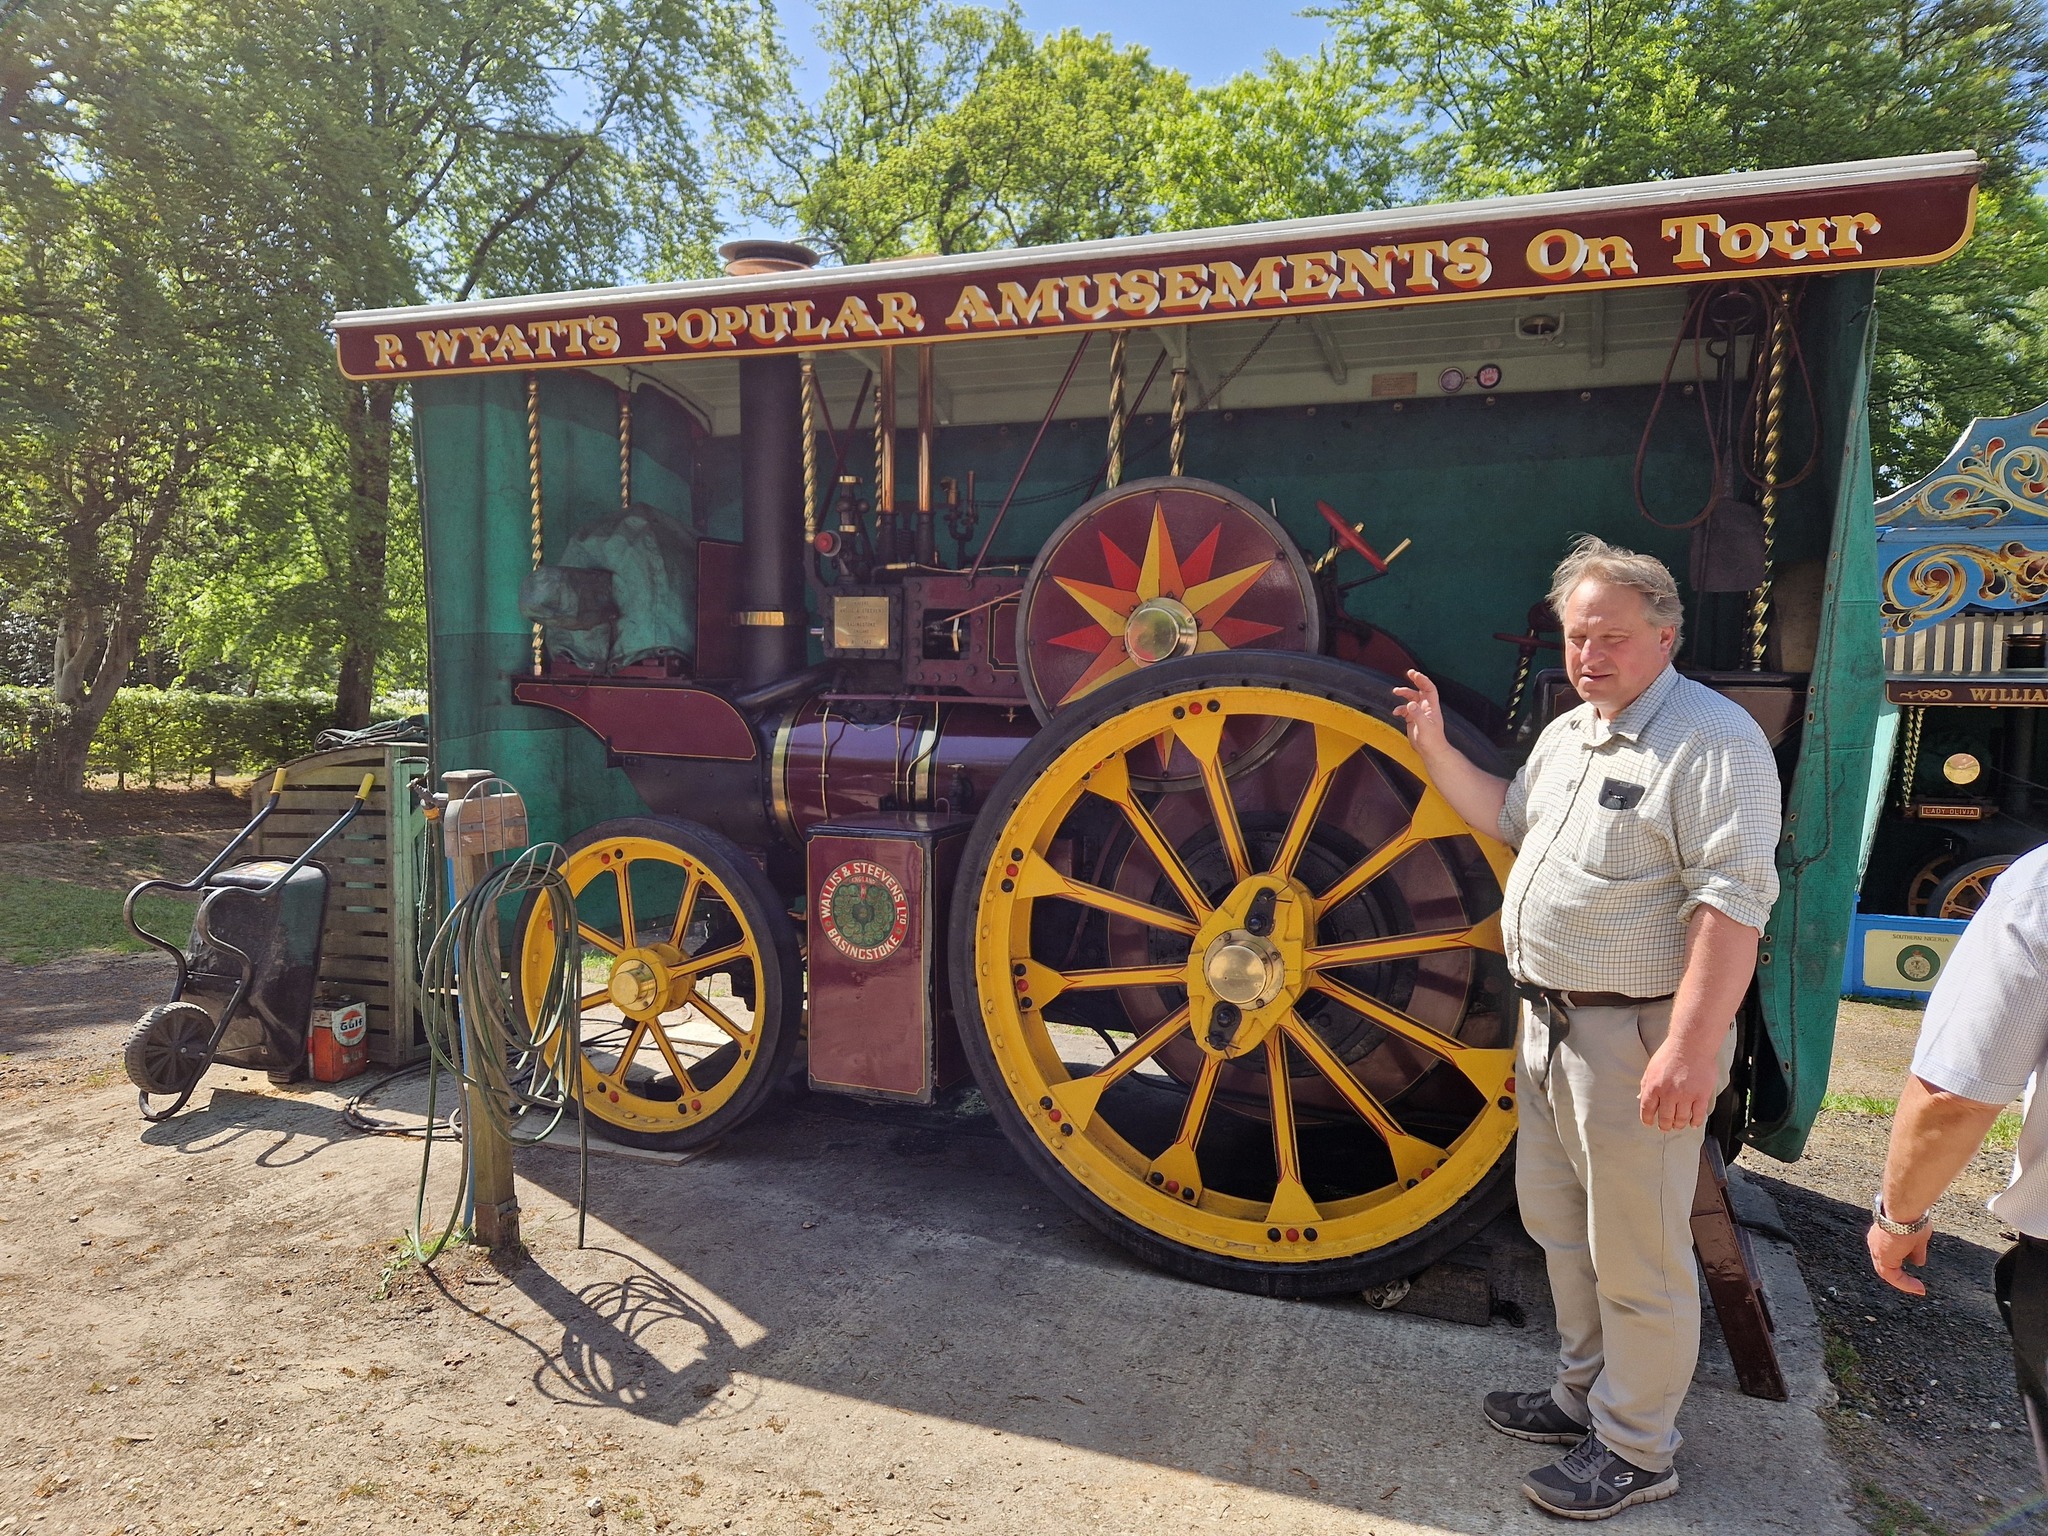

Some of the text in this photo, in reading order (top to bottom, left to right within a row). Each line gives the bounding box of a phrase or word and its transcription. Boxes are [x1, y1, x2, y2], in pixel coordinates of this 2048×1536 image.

[416, 315, 620, 367] WYATT'S
[642, 291, 925, 350] POPULAR
[944, 236, 1492, 331] AMUSEMENTS
[1526, 228, 1638, 280] On
[1661, 212, 1881, 269] Tour
[1969, 688, 2048, 702] WILLIA
[821, 862, 907, 925] WALLIS & STEEVENS LTD
[827, 928, 900, 960] BASINGSTOKE
[340, 1018, 363, 1031] Gulf
